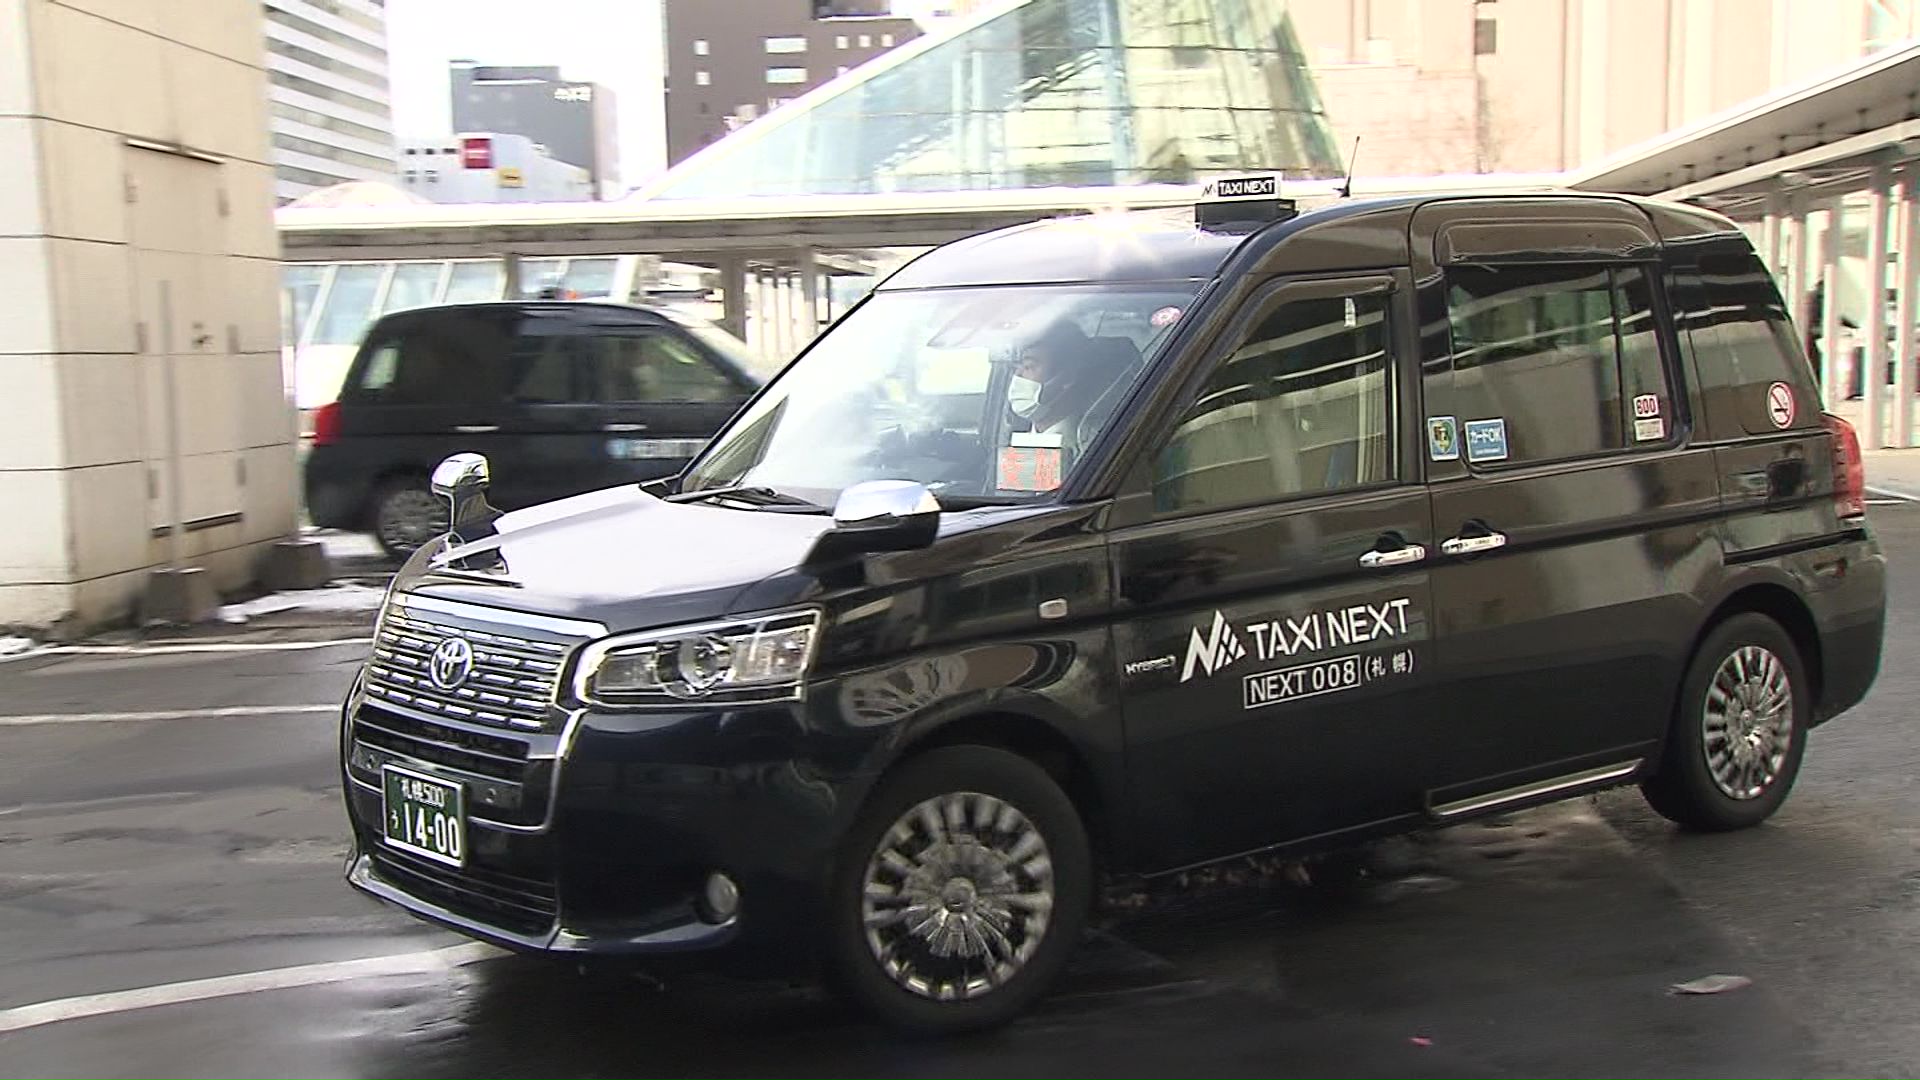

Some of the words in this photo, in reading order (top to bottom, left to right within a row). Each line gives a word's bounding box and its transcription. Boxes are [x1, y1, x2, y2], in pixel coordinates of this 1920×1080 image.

[1219, 181, 1243, 195] TAXI
[1243, 179, 1274, 194] NEXT
[1247, 614, 1323, 661] TAXI
[1326, 599, 1411, 649] NEXT
[1251, 669, 1307, 703] NEXT
[1311, 661, 1357, 691] 008
[403, 801, 461, 858] 14-00
